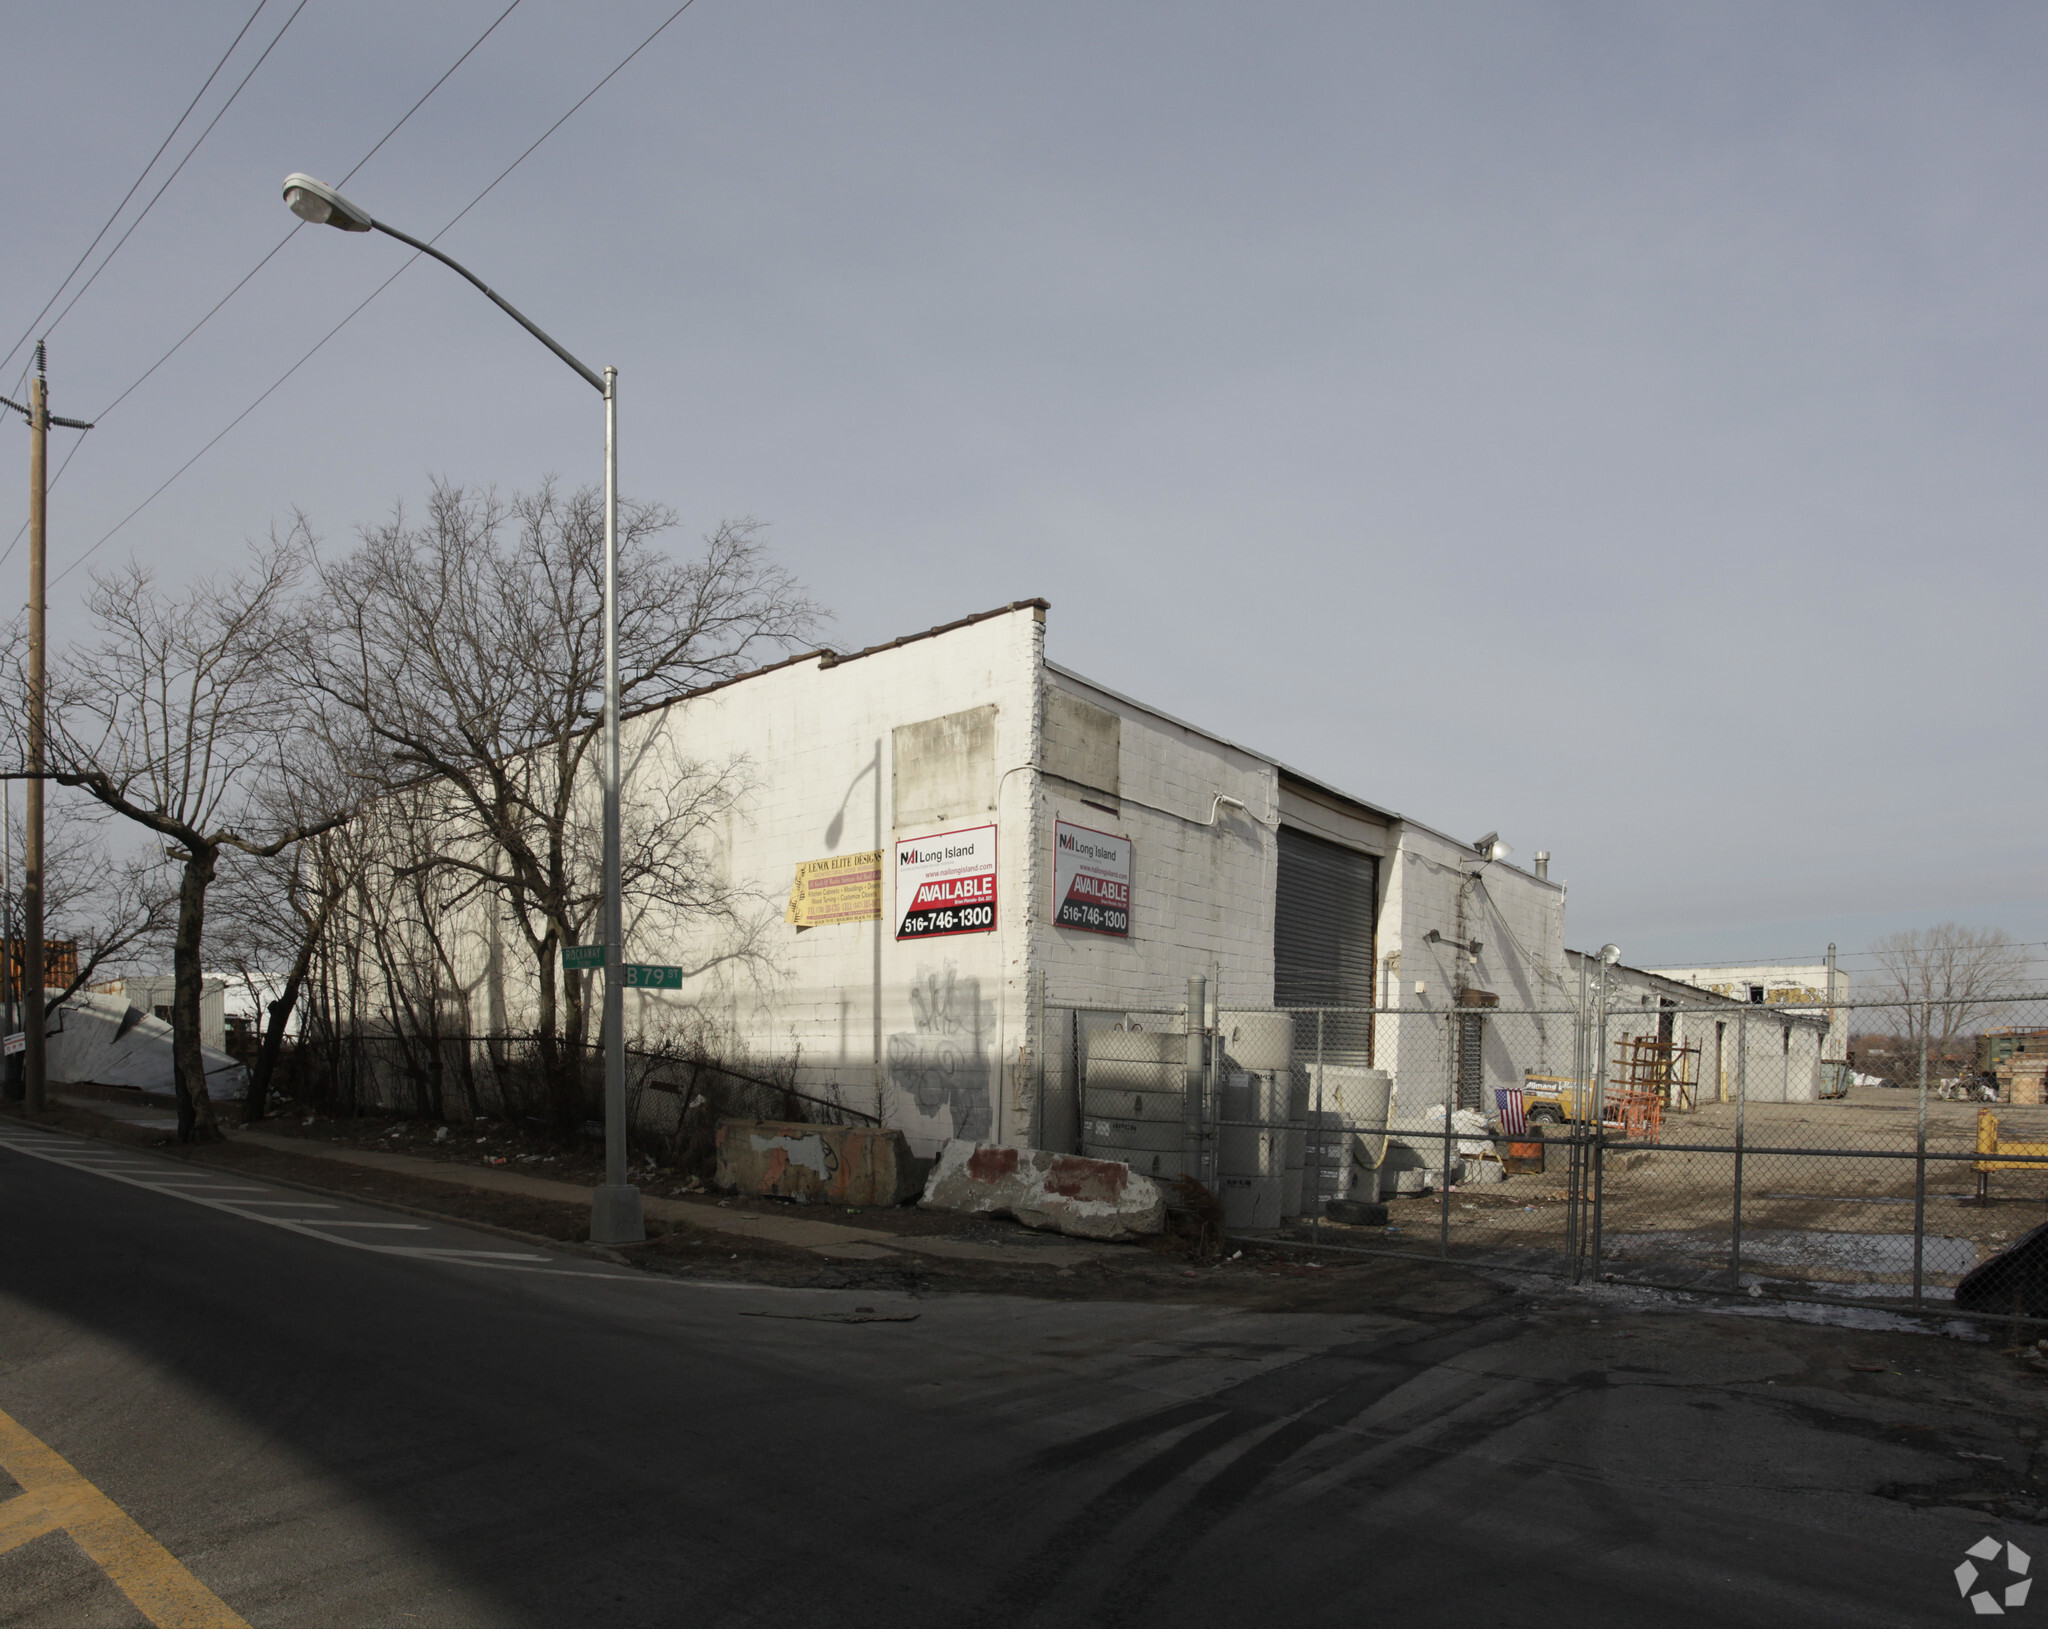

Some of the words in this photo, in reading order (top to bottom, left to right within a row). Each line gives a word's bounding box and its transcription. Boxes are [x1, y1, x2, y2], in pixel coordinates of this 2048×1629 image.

[900, 848, 918, 866] NAI
[920, 850, 942, 862] Long
[945, 843, 974, 859] Island
[1059, 833, 1075, 851] NAI
[1075, 840, 1094, 858] Long
[1095, 846, 1116, 861] Island
[808, 860, 830, 873] LENOX
[831, 857, 851, 871] ELITE
[854, 852, 881, 866] DESIGNS
[925, 863, 992, 878] www.nailongisland.com
[1079, 864, 1127, 880] www.nailongisland.com
[823, 888, 840, 896] Cabinets
[917, 877, 992, 903] AVAILABLE
[1073, 876, 1127, 902] AVAILABLE
[905, 906, 992, 933] 516-746-1300
[1063, 905, 1127, 930] 516-746-1300
[565, 947, 601, 960] ROCKAWAY
[627, 967, 638, 984] B
[642, 968, 665, 985] 79
[667, 969, 679, 979] ST
